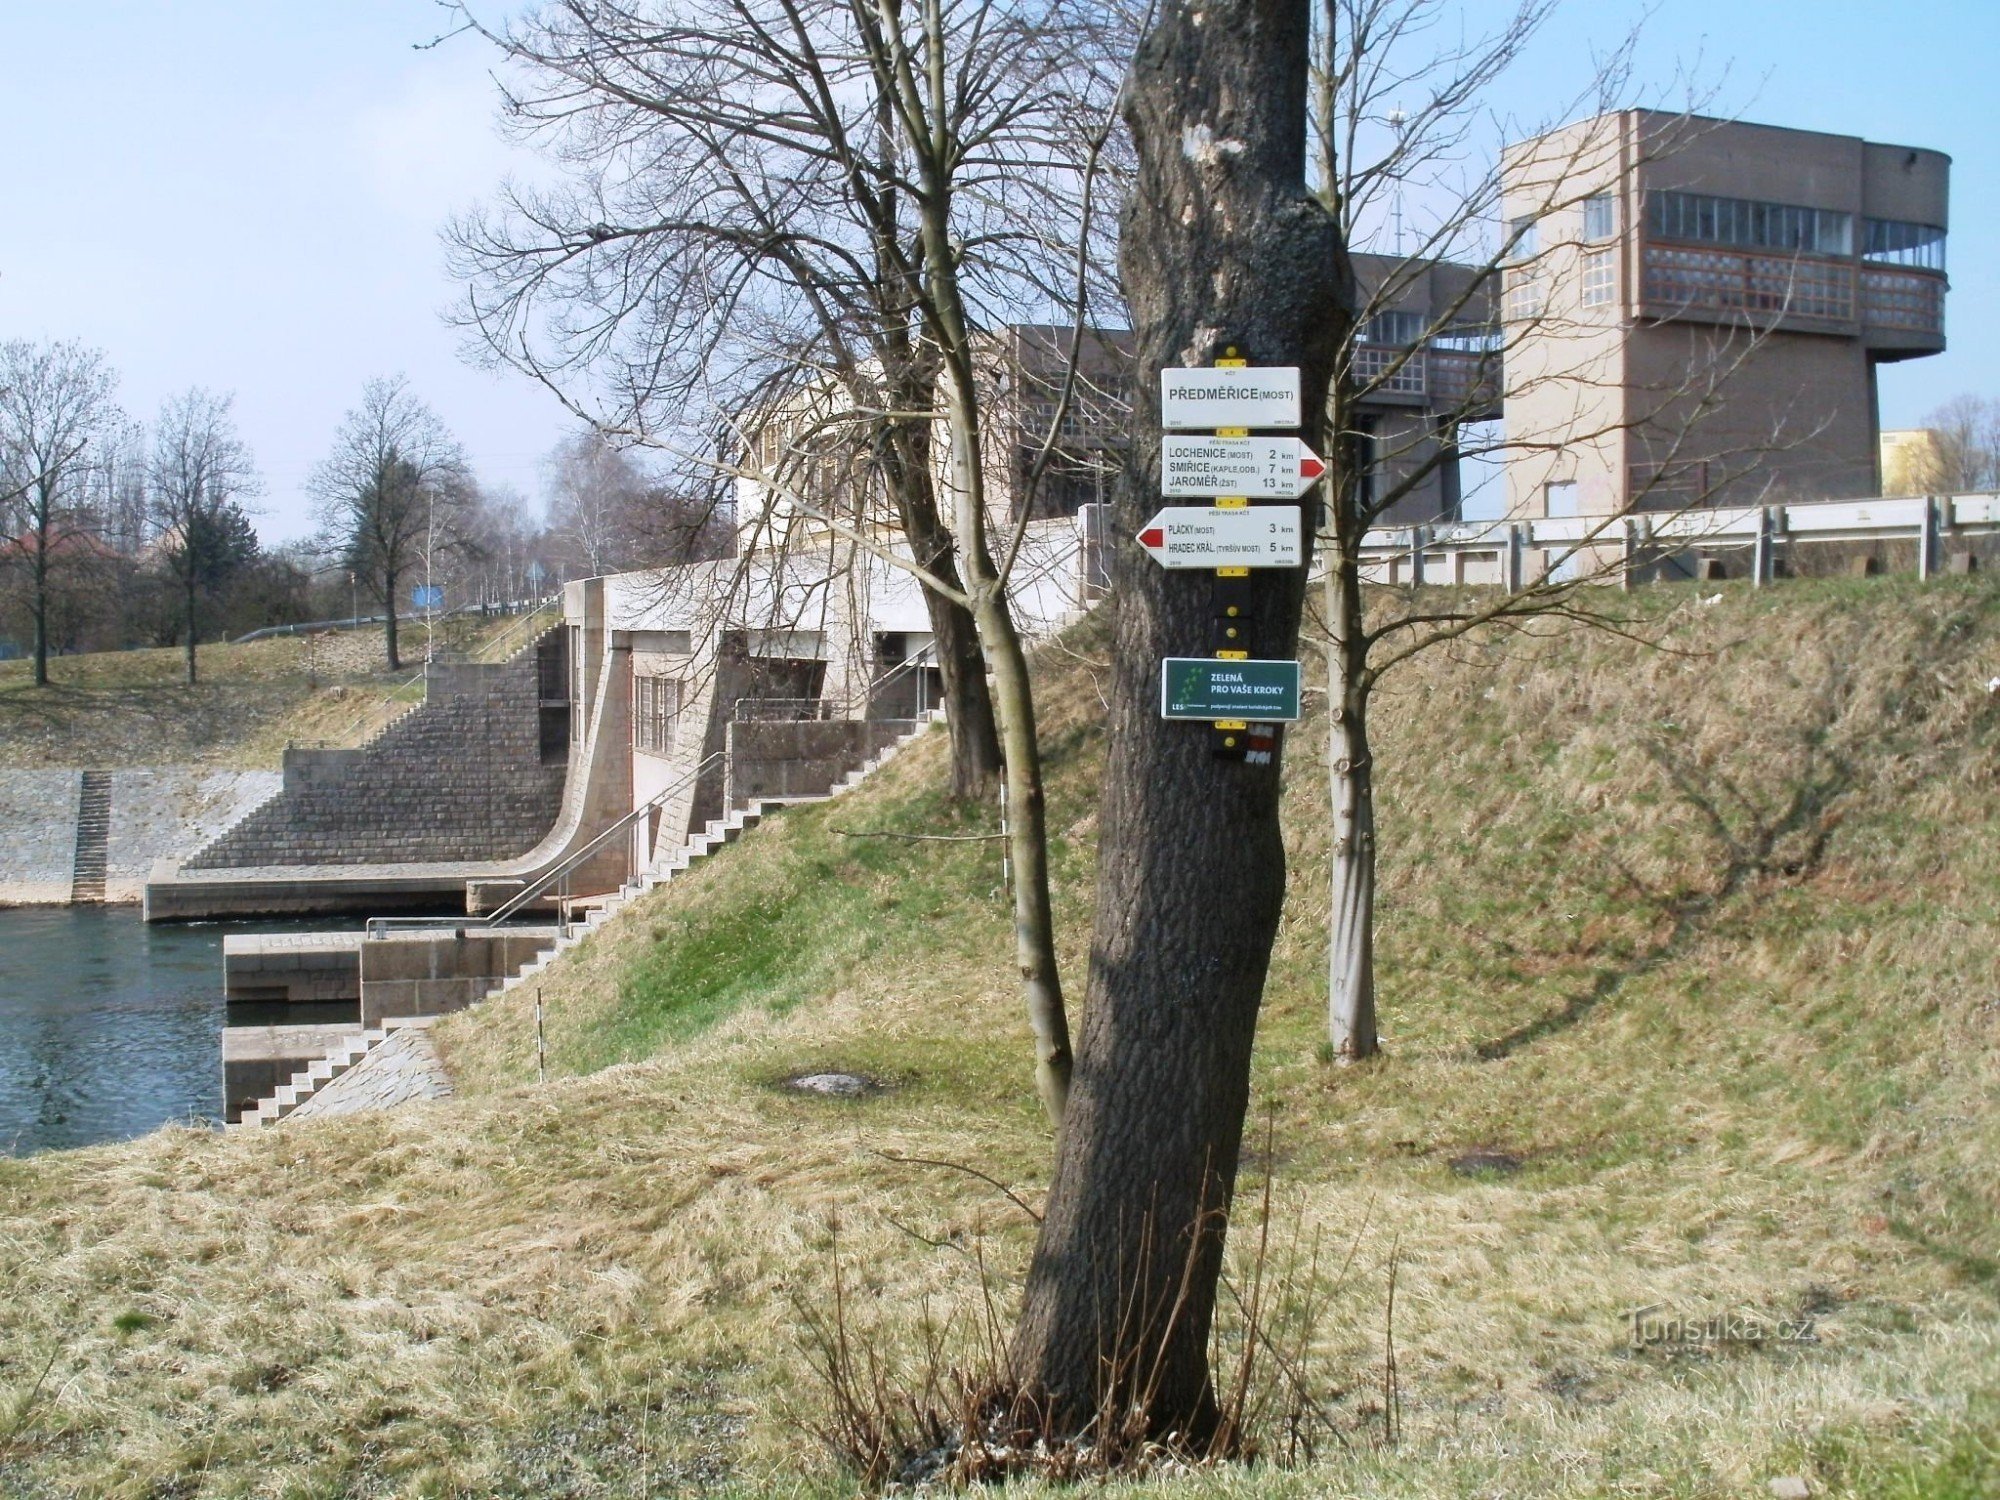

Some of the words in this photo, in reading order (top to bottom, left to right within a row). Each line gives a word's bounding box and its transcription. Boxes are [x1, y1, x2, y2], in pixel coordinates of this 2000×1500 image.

[1169, 386, 1258, 400] PŘEDMĚŘICE
[1259, 390, 1293, 401] (MOST)
[1169, 448, 1226, 458] LOCHENICE
[1227, 451, 1253, 460] (MOST)
[1269, 449, 1276, 460] 2
[1169, 461, 1210, 472] SMIŘICE
[1269, 464, 1276, 473] 7
[1169, 475, 1218, 487] JAROMĚŘ
[1263, 478, 1276, 488] 13
[1194, 526, 1215, 535] (MOST)
[1269, 523, 1277, 533] 3
[1168, 542, 1196, 553] HRADEC
[1241, 545, 1260, 554] MOST)
[1269, 542, 1277, 552] 5
[1211, 673, 1243, 682] ZELENÁ
[1211, 685, 1229, 694] PRO
[1230, 684, 1252, 694] VAŠE
[1254, 686, 1284, 695] KROKY
